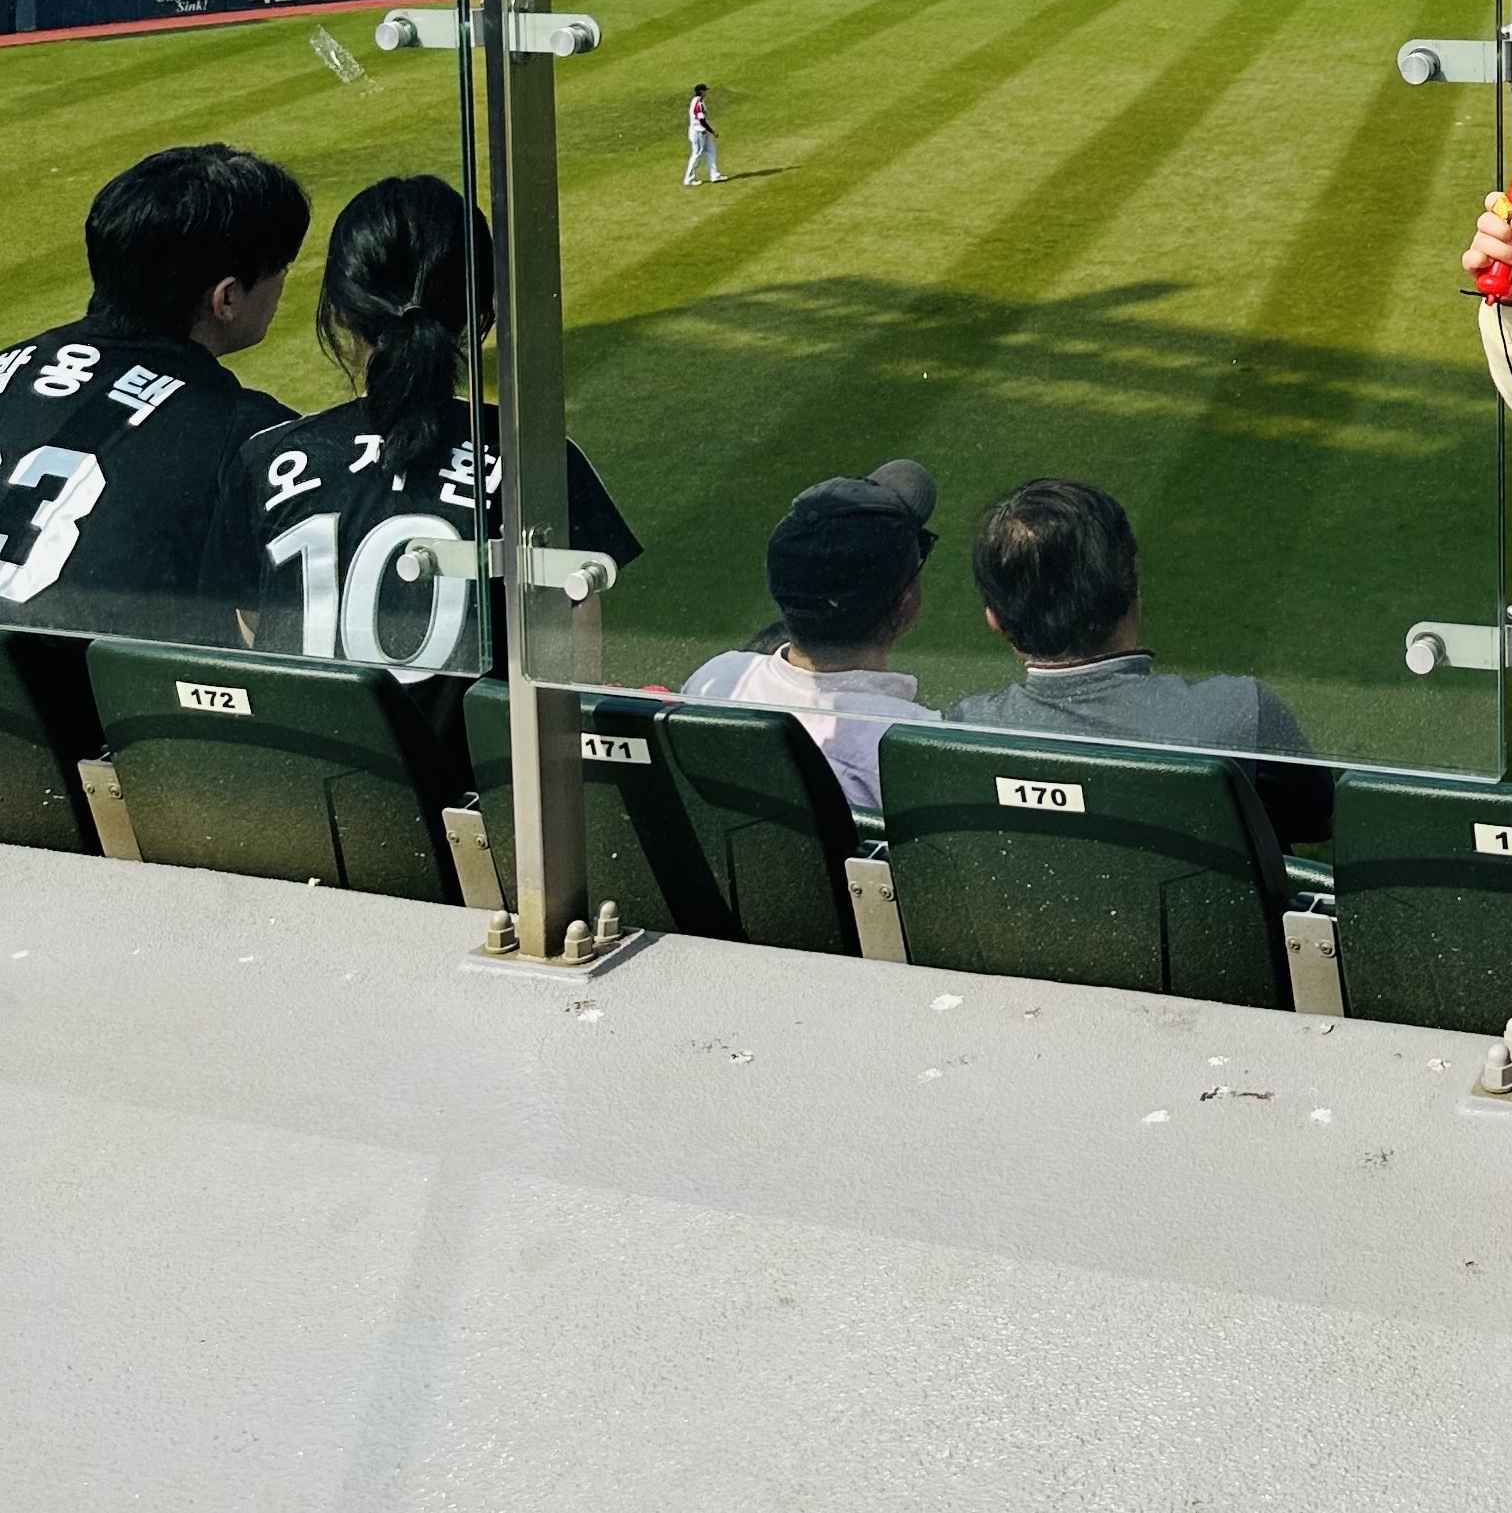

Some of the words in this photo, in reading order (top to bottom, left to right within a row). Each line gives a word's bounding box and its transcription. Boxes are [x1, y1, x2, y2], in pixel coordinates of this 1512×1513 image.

[176, 0, 208, 13] Sink!
[266, 512, 470, 684] 10
[191, 689, 235, 709] 172
[585, 739, 632, 760] 171
[1014, 784, 1068, 807] 170
